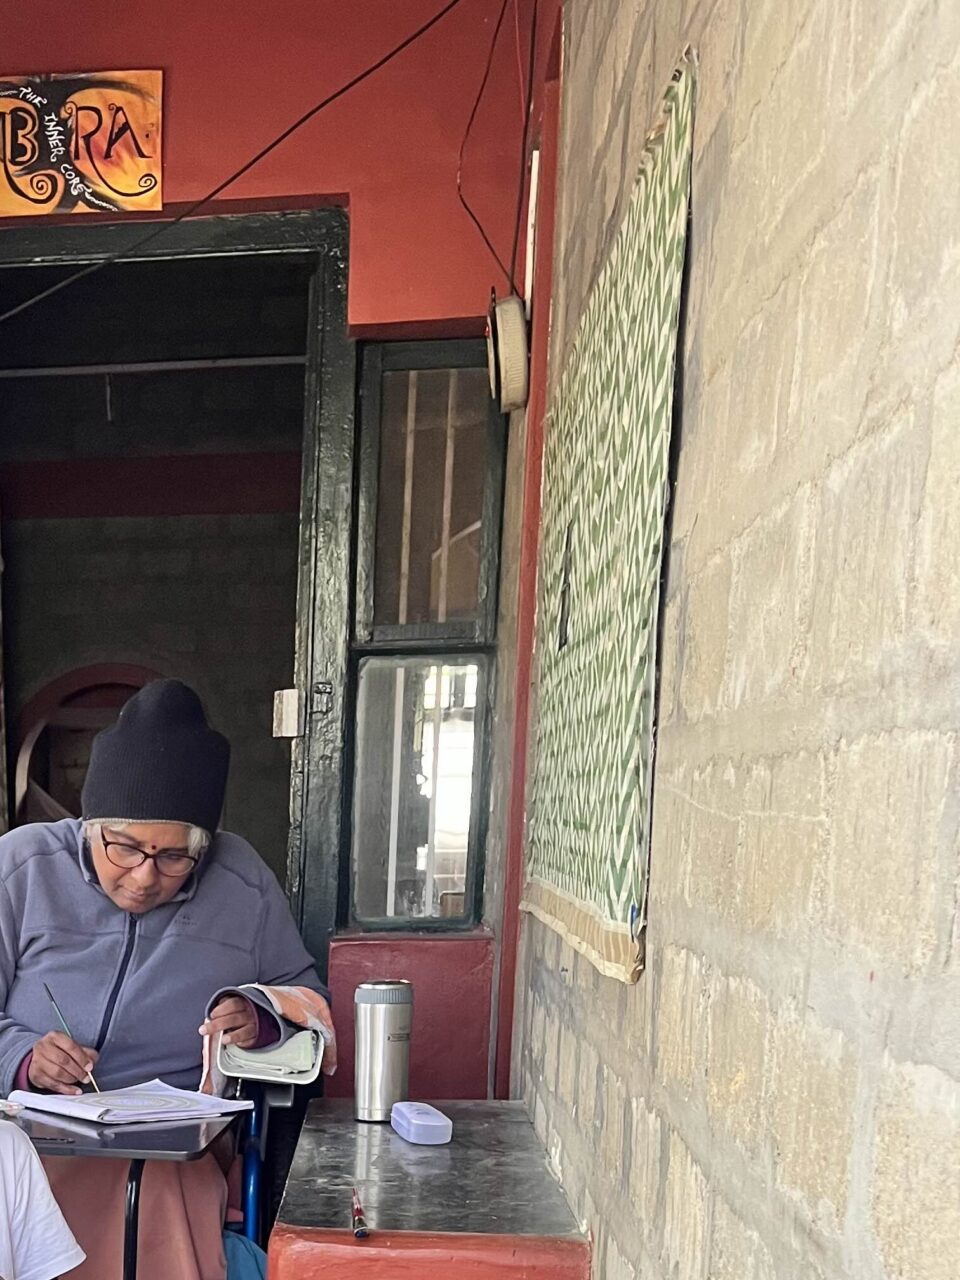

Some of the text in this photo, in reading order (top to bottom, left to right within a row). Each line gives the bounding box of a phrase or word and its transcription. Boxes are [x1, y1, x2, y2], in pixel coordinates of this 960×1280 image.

[18, 87, 91, 197] THE INNER CORE
